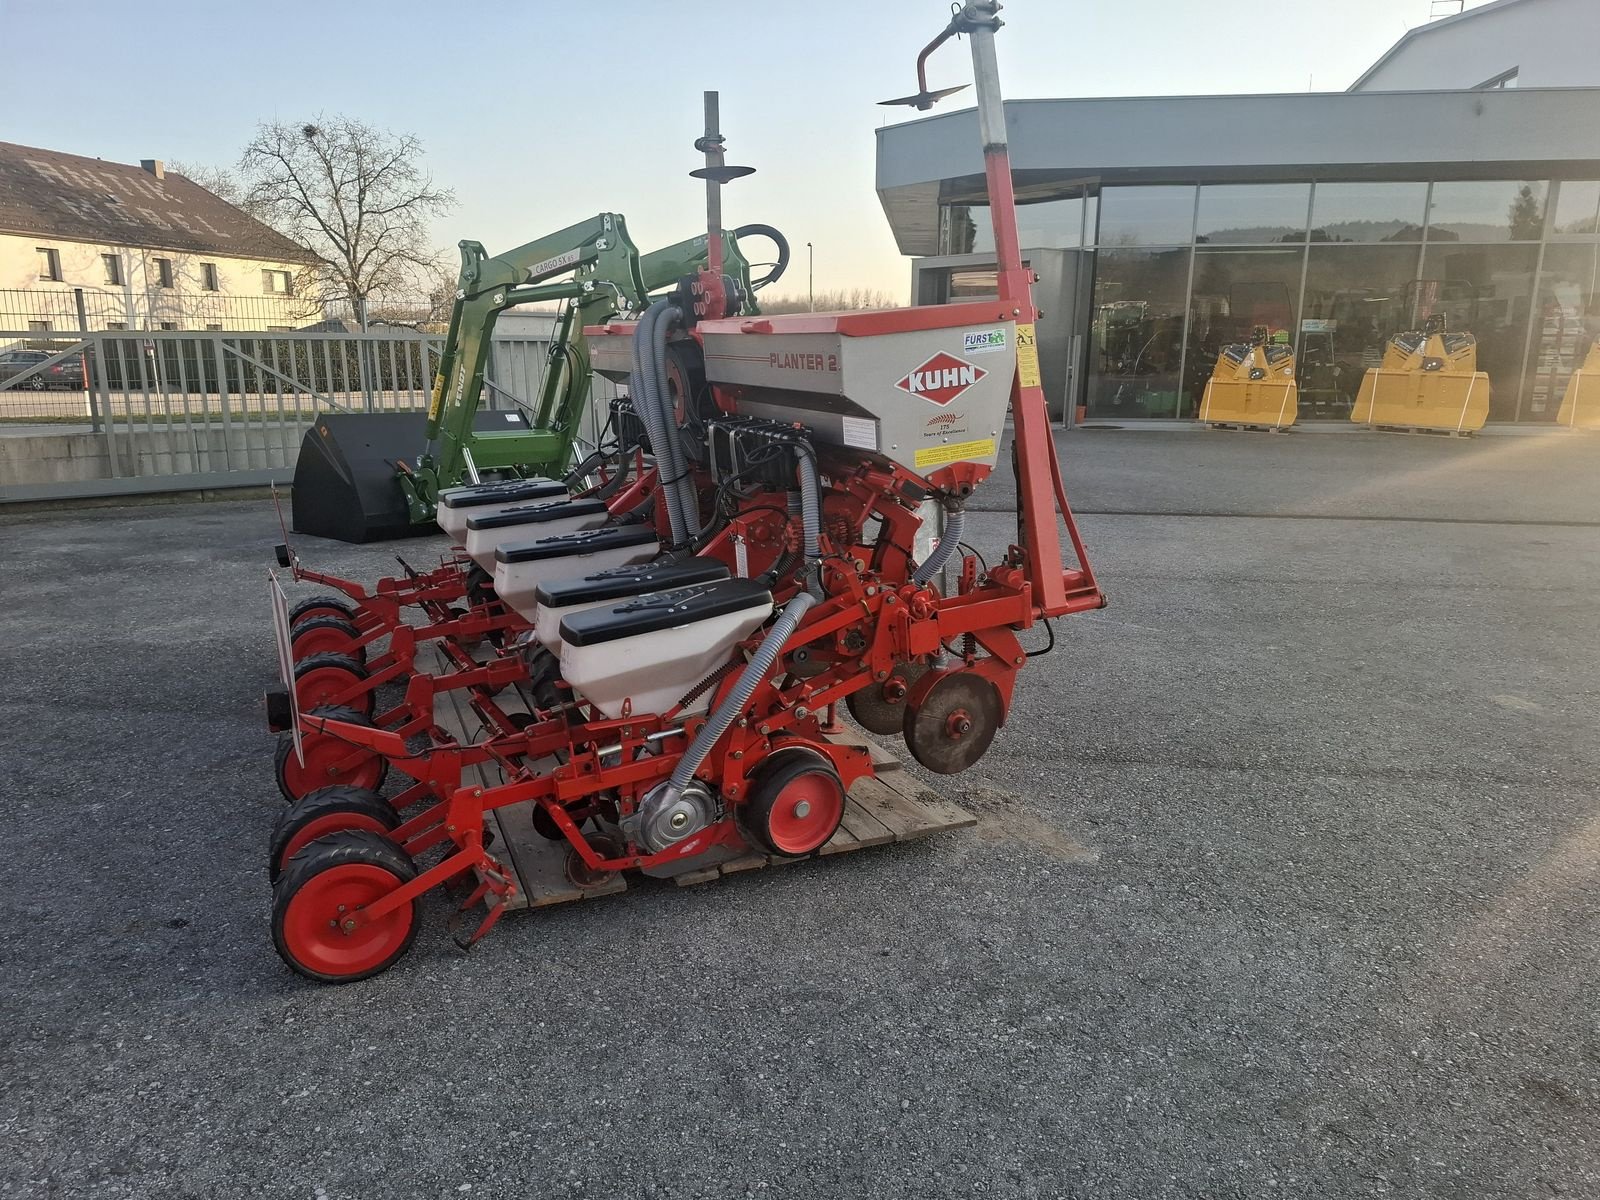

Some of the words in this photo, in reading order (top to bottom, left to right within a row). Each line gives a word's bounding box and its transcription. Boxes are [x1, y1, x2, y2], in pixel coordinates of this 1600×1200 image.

[535, 259, 558, 273] CARGO
[769, 352, 824, 371] PLANTER
[828, 354, 837, 372] 2
[455, 363, 466, 407] FENDT
[908, 365, 976, 393] KUHN
